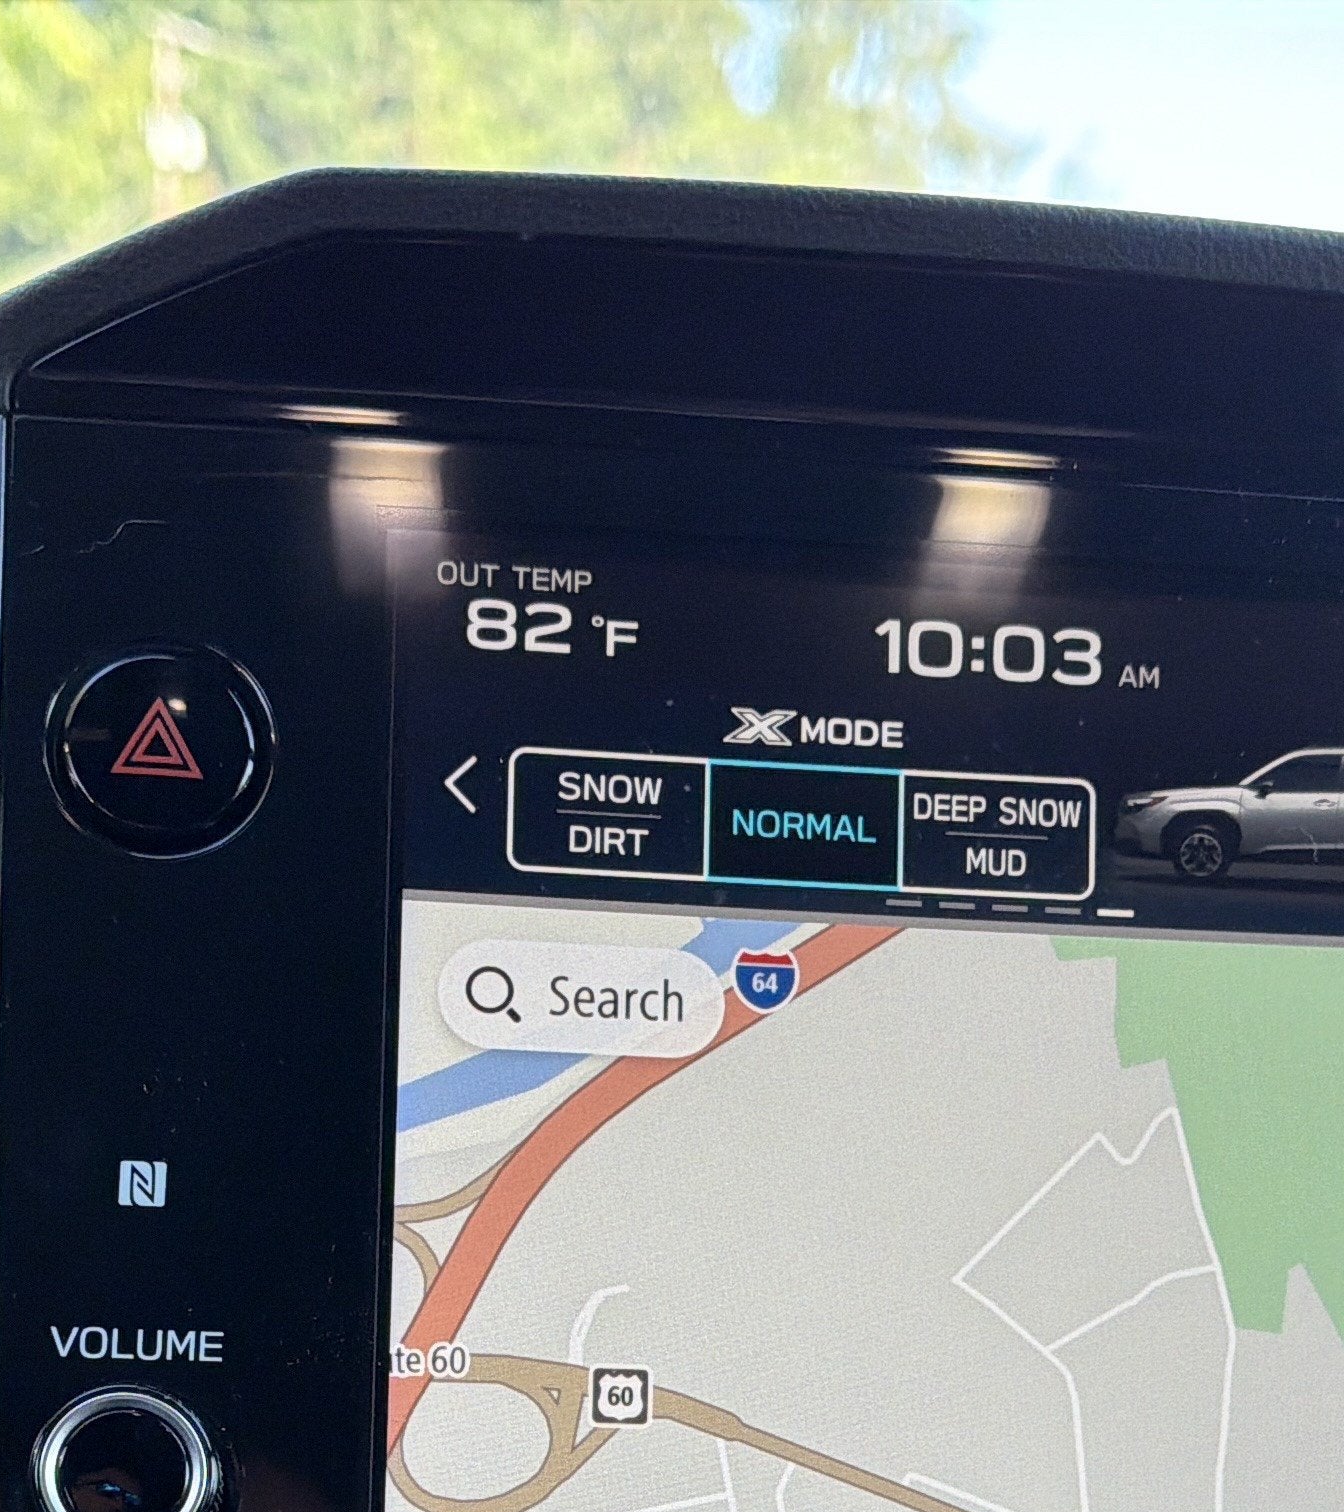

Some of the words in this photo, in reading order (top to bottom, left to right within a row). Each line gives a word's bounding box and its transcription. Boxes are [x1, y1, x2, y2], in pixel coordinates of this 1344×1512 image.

[437, 560, 500, 588] OUT
[512, 564, 593, 593] TEMP
[466, 599, 572, 654] 82
[874, 618, 1103, 688] 10:03
[1118, 663, 1161, 690] AM
[799, 717, 904, 749] MODE
[557, 770, 662, 806] SNOW
[730, 808, 877, 845] NORMAL
[913, 792, 988, 825] DEEP
[998, 795, 1082, 830] SNOW
[568, 823, 651, 857] DIRT
[965, 845, 1028, 880] MUD
[549, 976, 684, 1023] Search
[752, 972, 778, 994] 64
[51, 1326, 224, 1361] VOLUME
[430, 1345, 467, 1374] 60
[607, 1386, 634, 1407] 60
